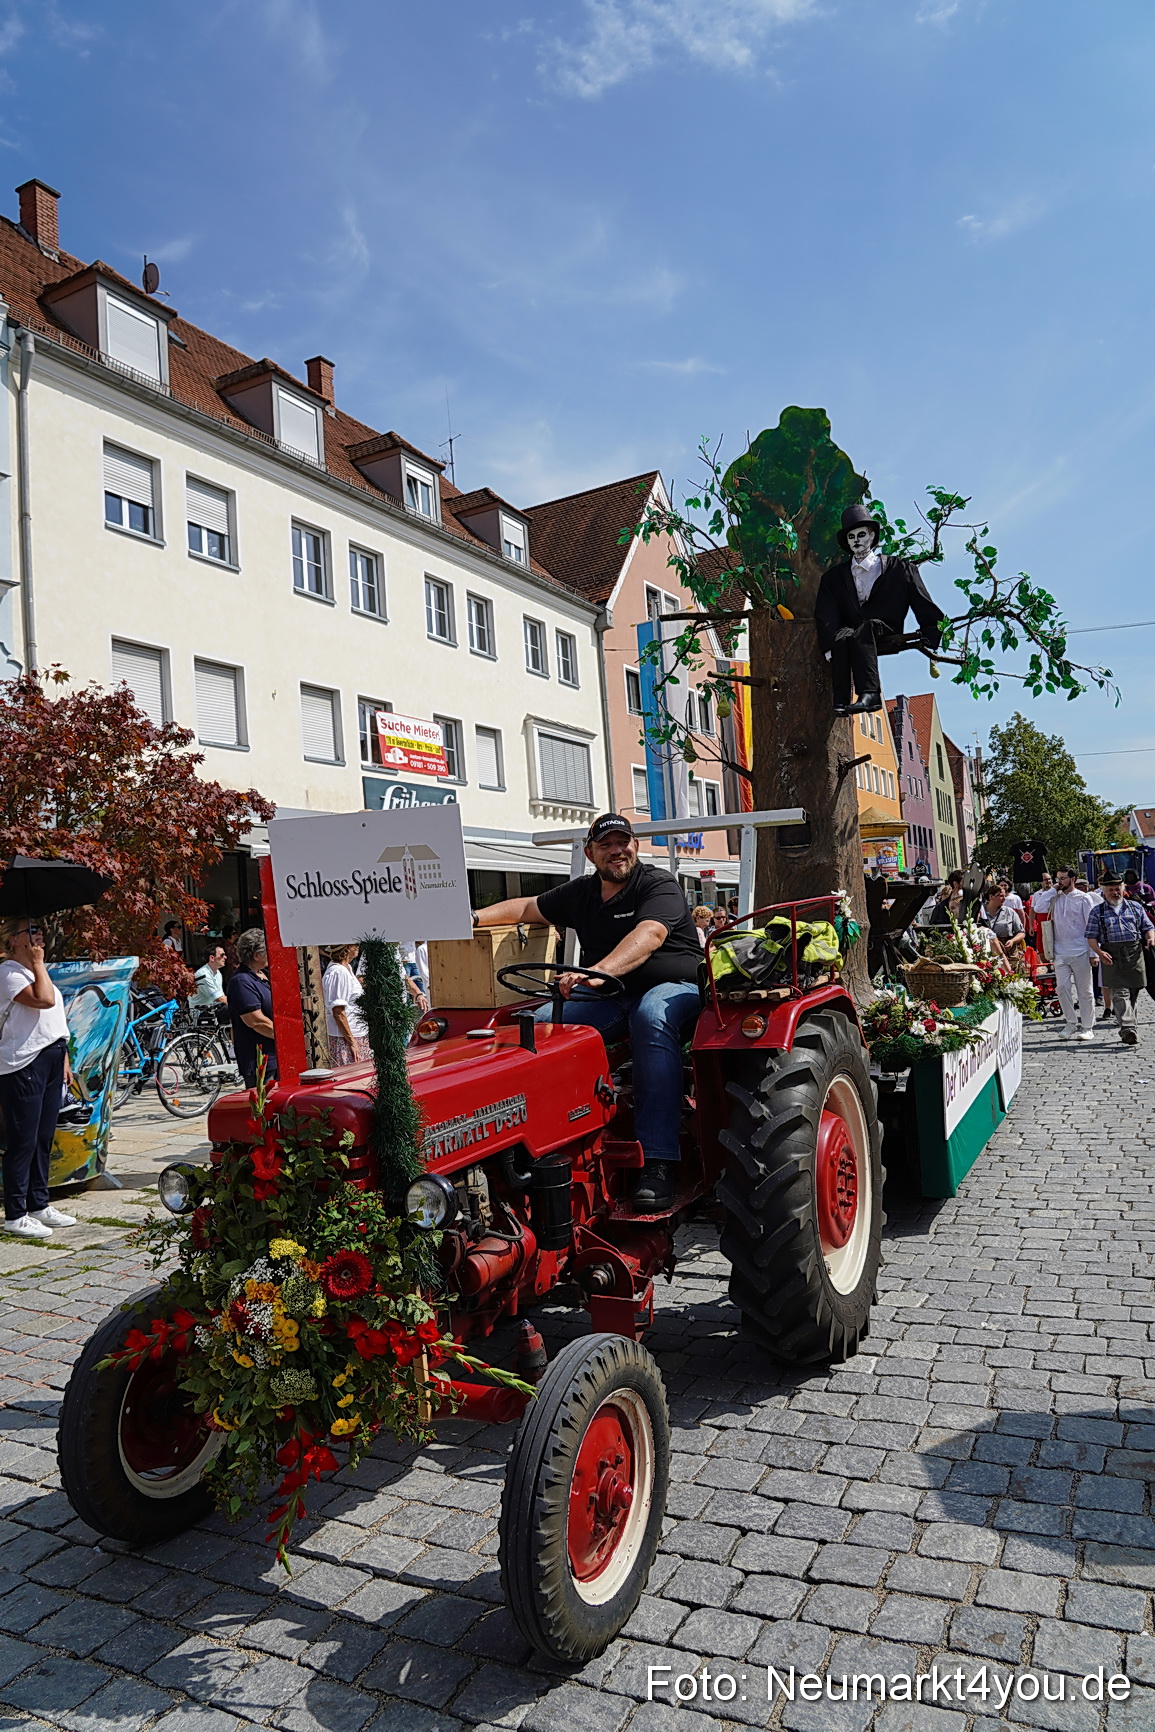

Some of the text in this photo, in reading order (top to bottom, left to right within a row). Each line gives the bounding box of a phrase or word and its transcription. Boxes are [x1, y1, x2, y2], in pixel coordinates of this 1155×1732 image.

[380, 718, 411, 734] Suche
[380, 785, 454, 810] früh
[599, 819, 626, 829] HITACHI
[286, 865, 403, 904] Schloss-Spiele
[419, 880, 448, 890] Neumarkt
